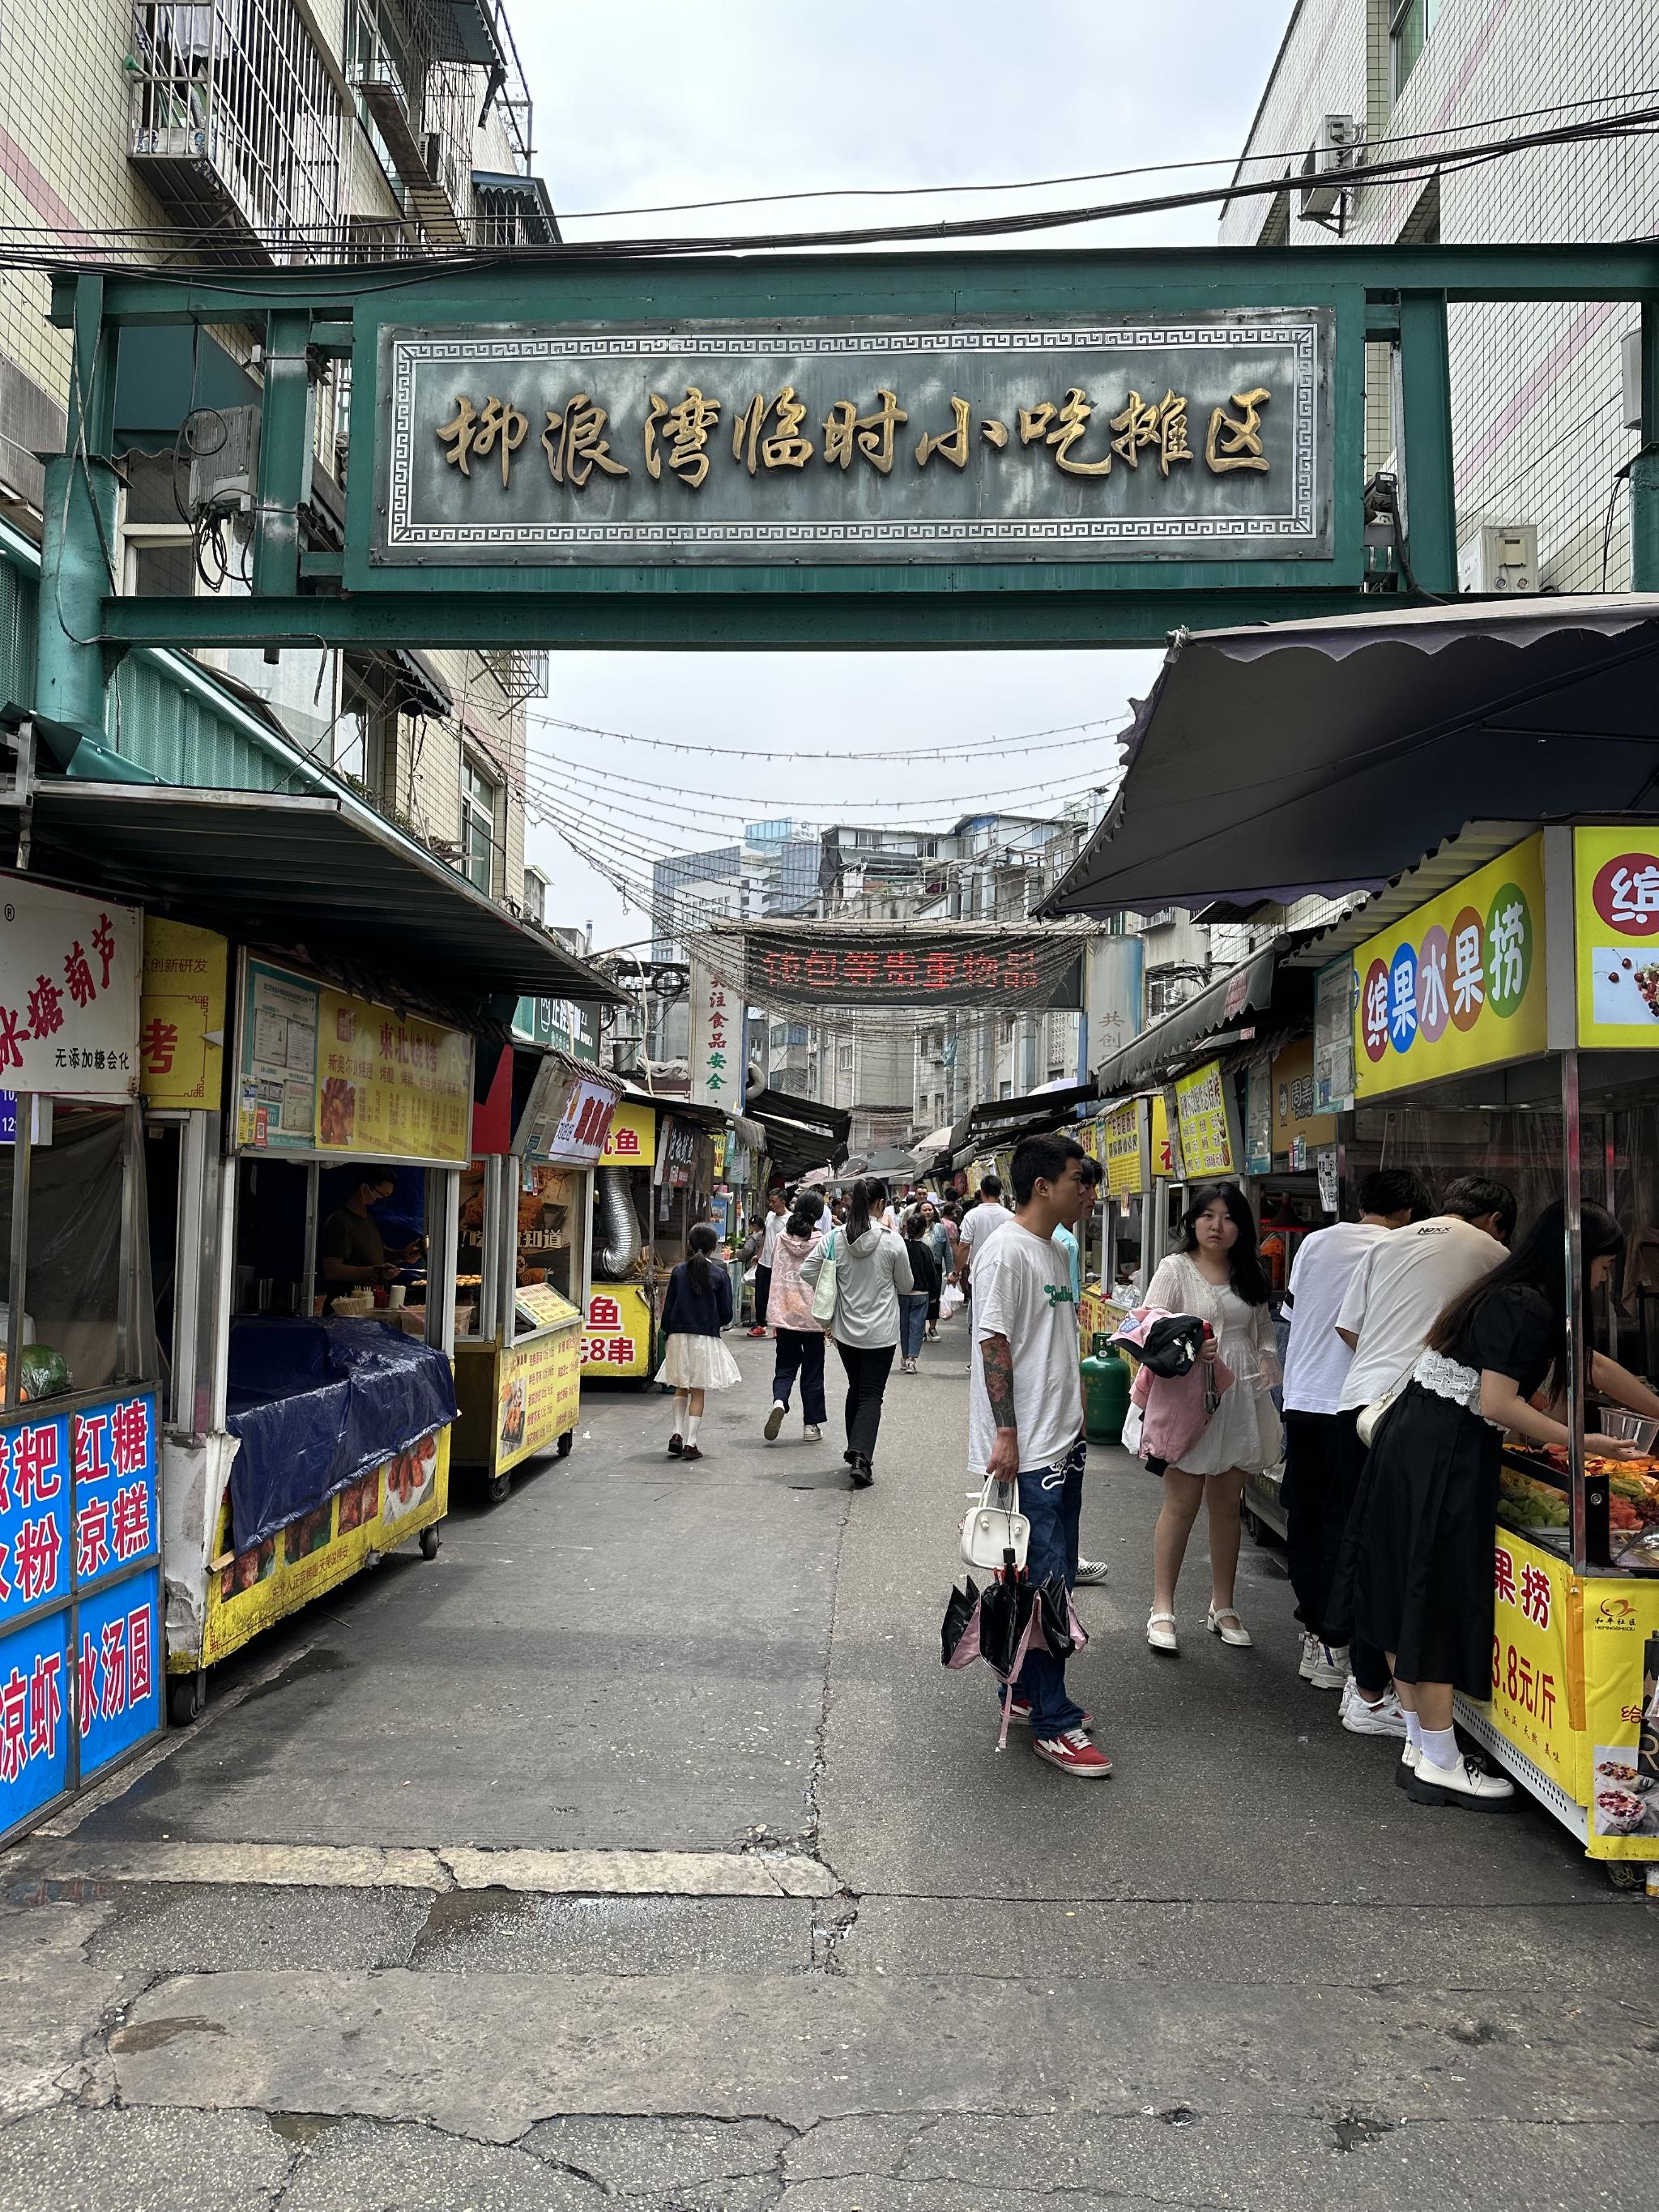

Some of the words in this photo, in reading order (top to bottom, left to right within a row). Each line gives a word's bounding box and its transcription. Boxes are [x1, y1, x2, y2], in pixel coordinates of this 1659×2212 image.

[437, 386, 1271, 488] 柳浪湾临时小吃摊区
[55, 1047, 130, 1071] 无添加糖会化
[1595, 1617, 1636, 1626] 和平社区
